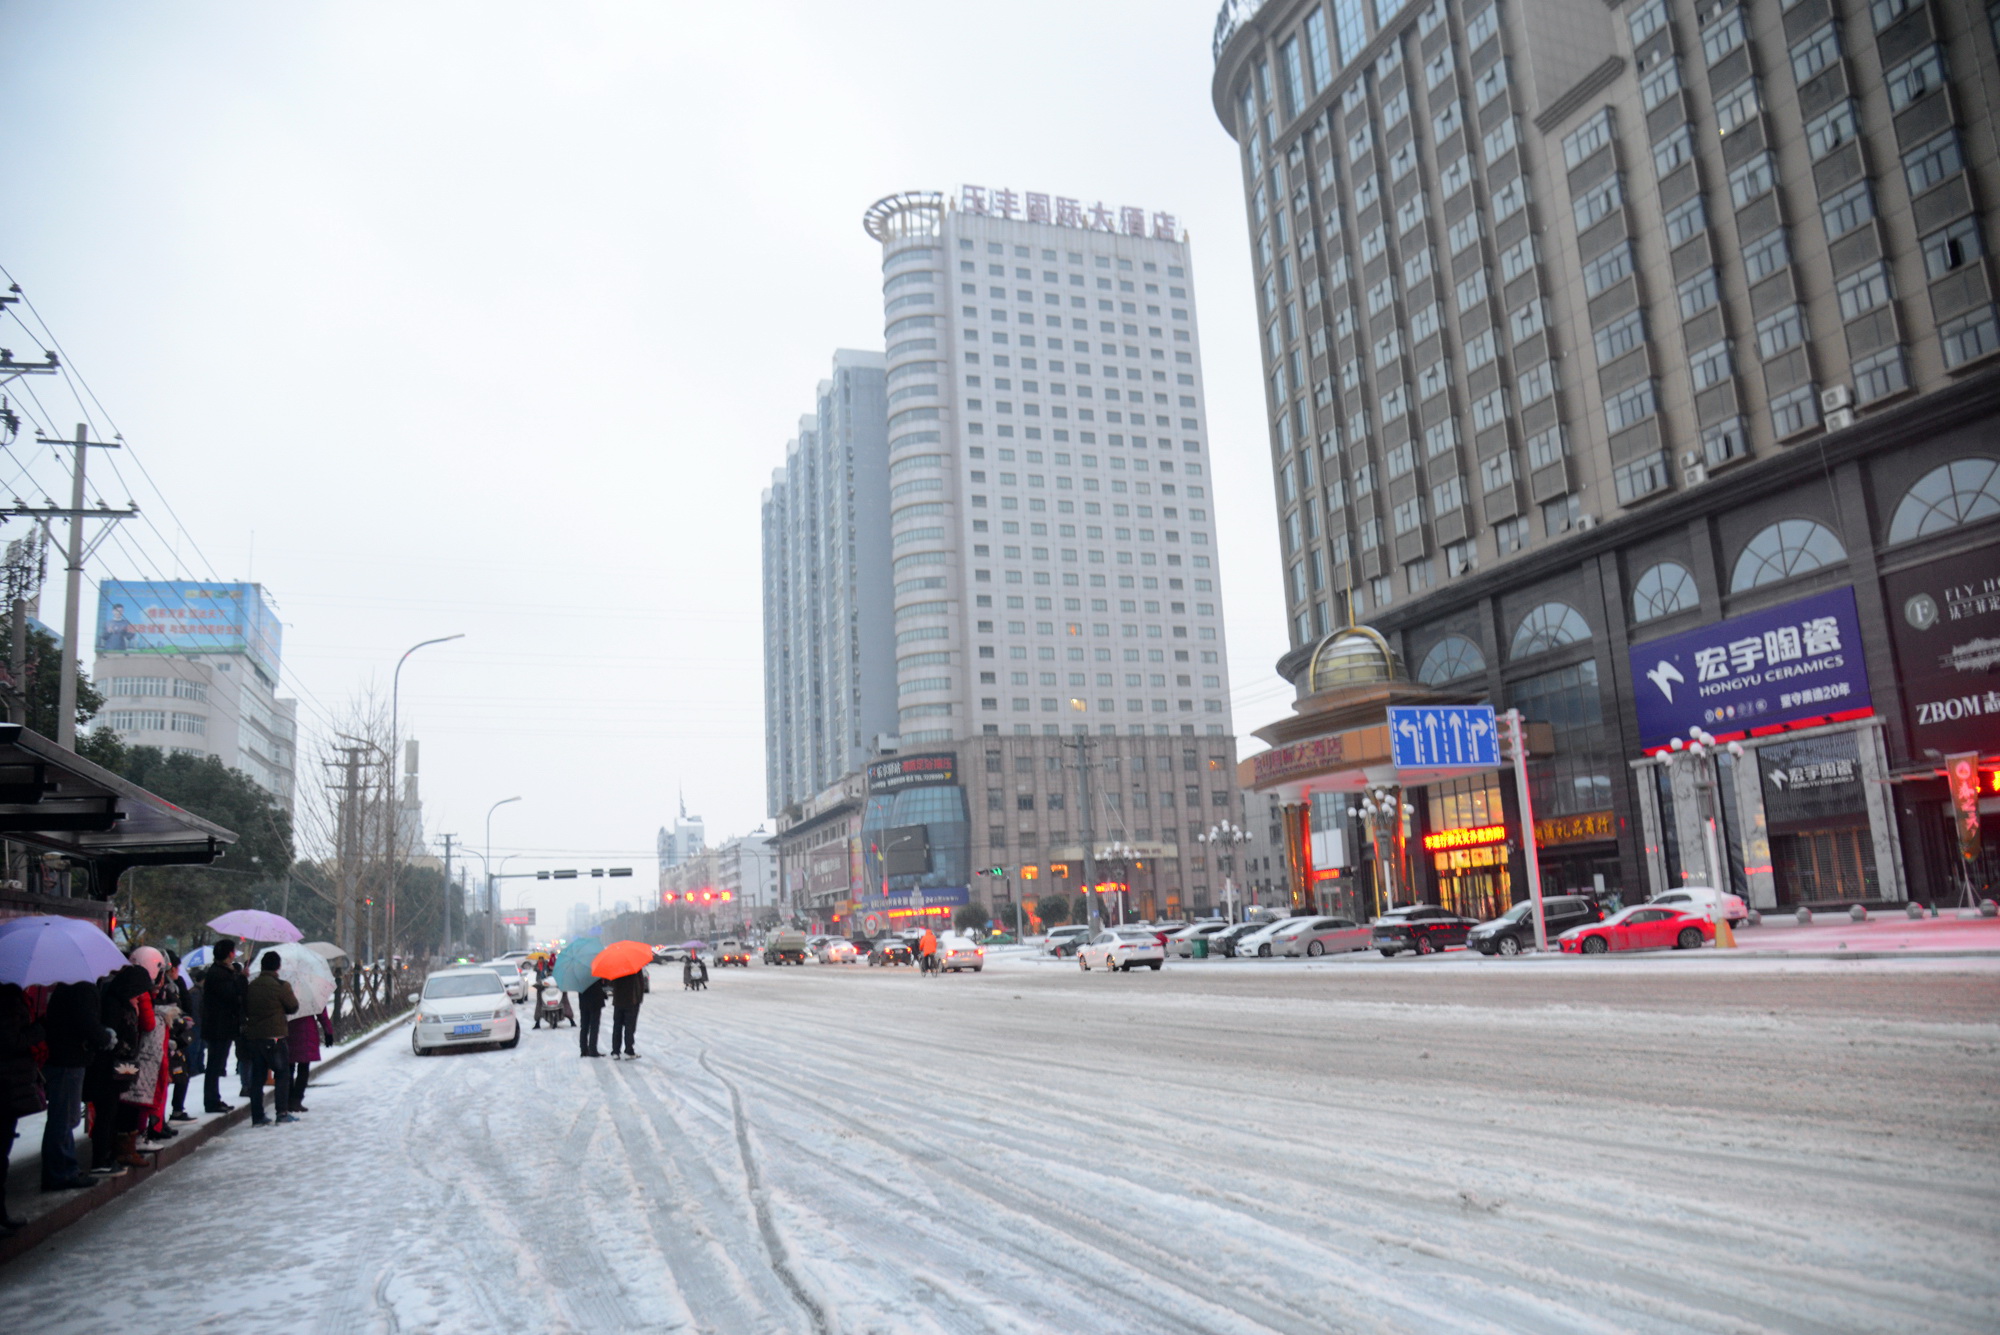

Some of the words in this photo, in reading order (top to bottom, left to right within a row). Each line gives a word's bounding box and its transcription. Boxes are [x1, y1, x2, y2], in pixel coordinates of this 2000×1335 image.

[1694, 616, 1842, 683] 宏宇陶瓷
[1699, 673, 1762, 698] HONGYU
[1765, 654, 1845, 683] CERAMICS
[1916, 694, 1981, 725] ZBOM
[1788, 760, 1853, 783] 宏宇陶瓷
